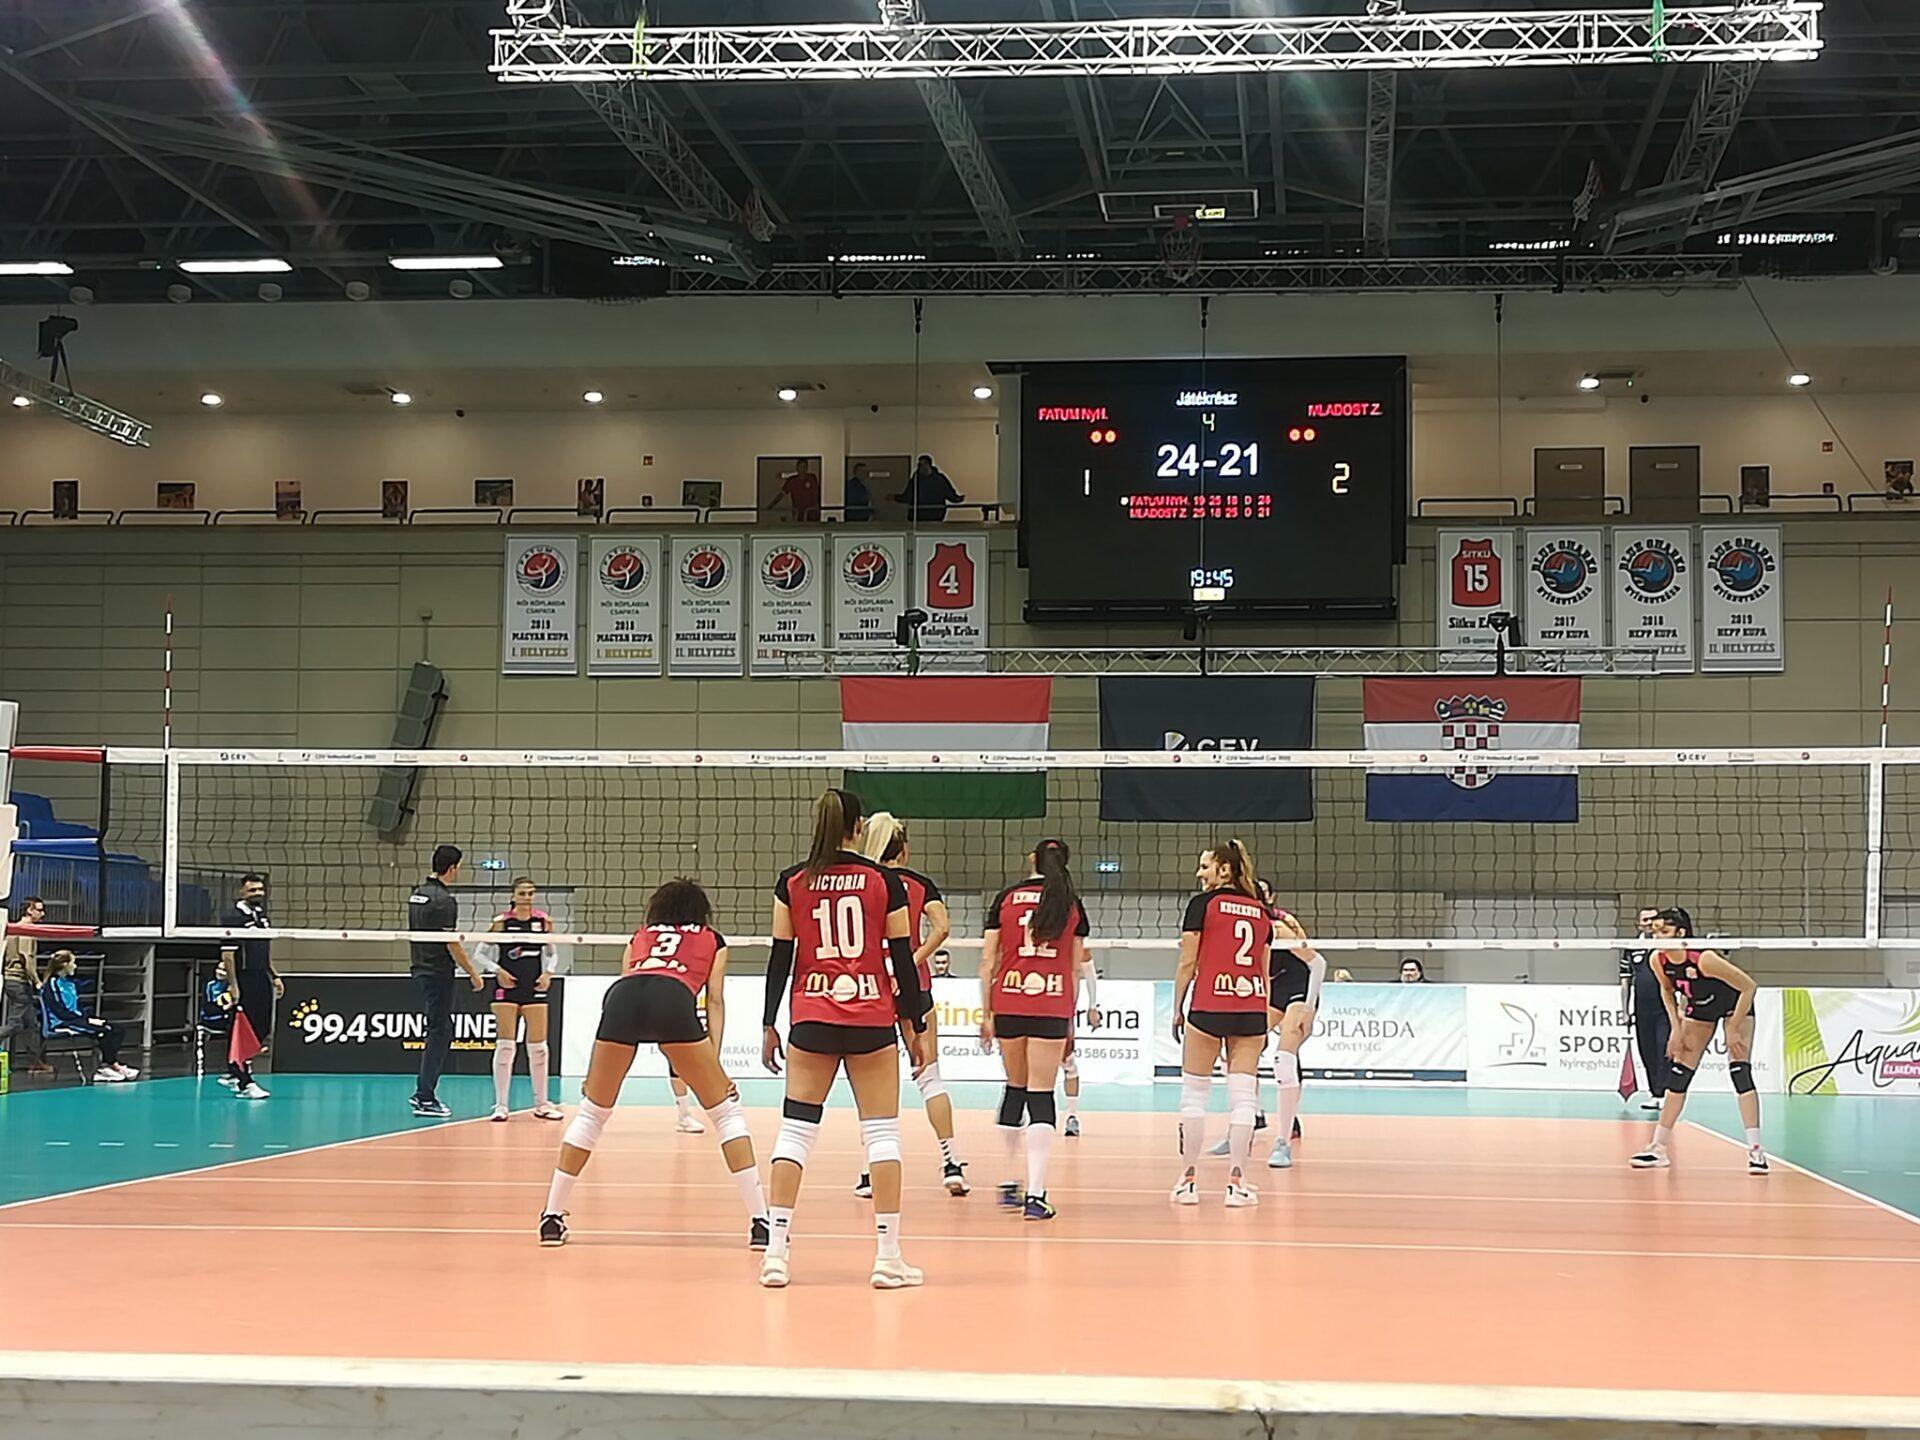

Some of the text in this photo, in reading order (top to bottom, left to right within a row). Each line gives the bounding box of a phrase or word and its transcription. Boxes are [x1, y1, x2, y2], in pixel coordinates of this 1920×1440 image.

[1308, 402, 1369, 417] MLADOST
[1157, 442, 1259, 477] 24-21
[1332, 463, 1350, 494] 2
[1462, 550, 1491, 558] SITKU
[938, 565, 959, 594] 4
[1190, 569, 1234, 587] 19:45
[1464, 564, 1489, 592] 15
[1449, 617, 1476, 629] Sitku
[1554, 616, 1575, 626] 2017
[1642, 615, 1664, 626] 2018
[1731, 614, 1752, 624] 2019
[953, 626, 979, 636] Erika
[1566, 630, 1589, 639] KUPA
[1654, 629, 1677, 638] KUPA
[1743, 628, 1766, 636] KUPA
[812, 895, 864, 959] 10
[650, 932, 682, 957] 3
[1234, 920, 1254, 966] 2
[1332, 1006, 1376, 1016] MAGYAR
[304, 1013, 367, 1043] 99.4
[1311, 1016, 1415, 1038] ÓPLABDA
[943, 1046, 969, 1057] Géza
[1085, 1048, 1106, 1058] 586
[1109, 1049, 1139, 1059] 0533
